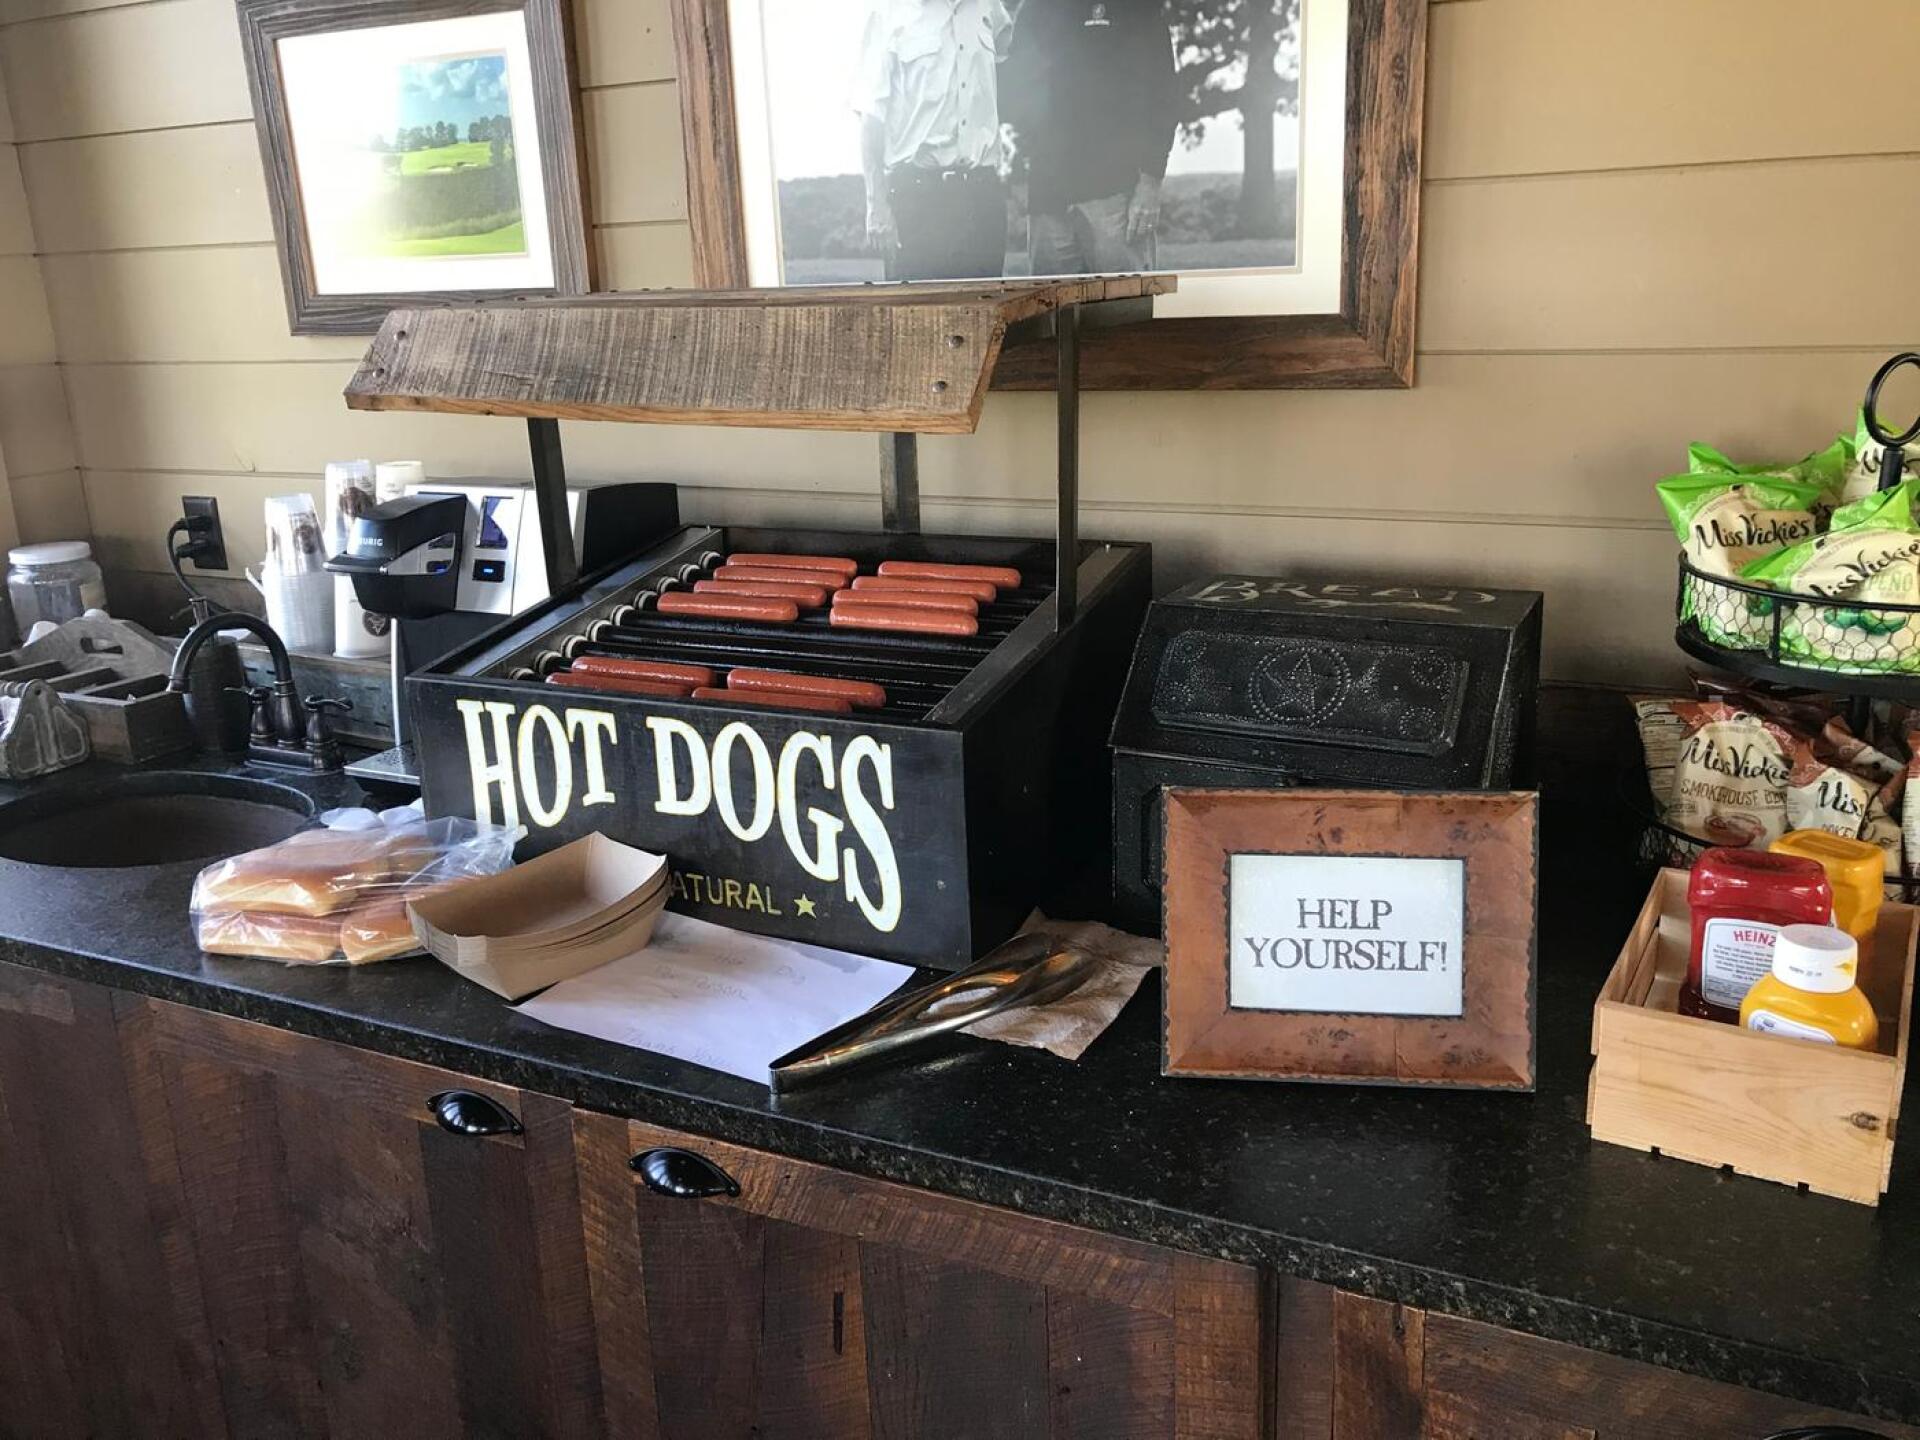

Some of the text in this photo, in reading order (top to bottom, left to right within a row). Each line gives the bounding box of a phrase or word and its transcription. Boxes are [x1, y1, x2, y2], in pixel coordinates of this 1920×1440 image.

[357, 536, 384, 547] URIG
[1695, 518, 1743, 556] Miss
[1738, 513, 1810, 548] Vickie's
[1833, 539, 1920, 578] Vickie
[1189, 580, 1497, 604] BREAD
[1680, 737, 1732, 776] Miss
[1728, 743, 1791, 789] Vickie
[456, 699, 902, 932] HOT DOGS
[670, 871, 783, 916] ATURAL
[1297, 898, 1393, 930] HELP
[1244, 937, 1448, 972] YOURSELF!
[1733, 929, 1777, 948] HEINZ
